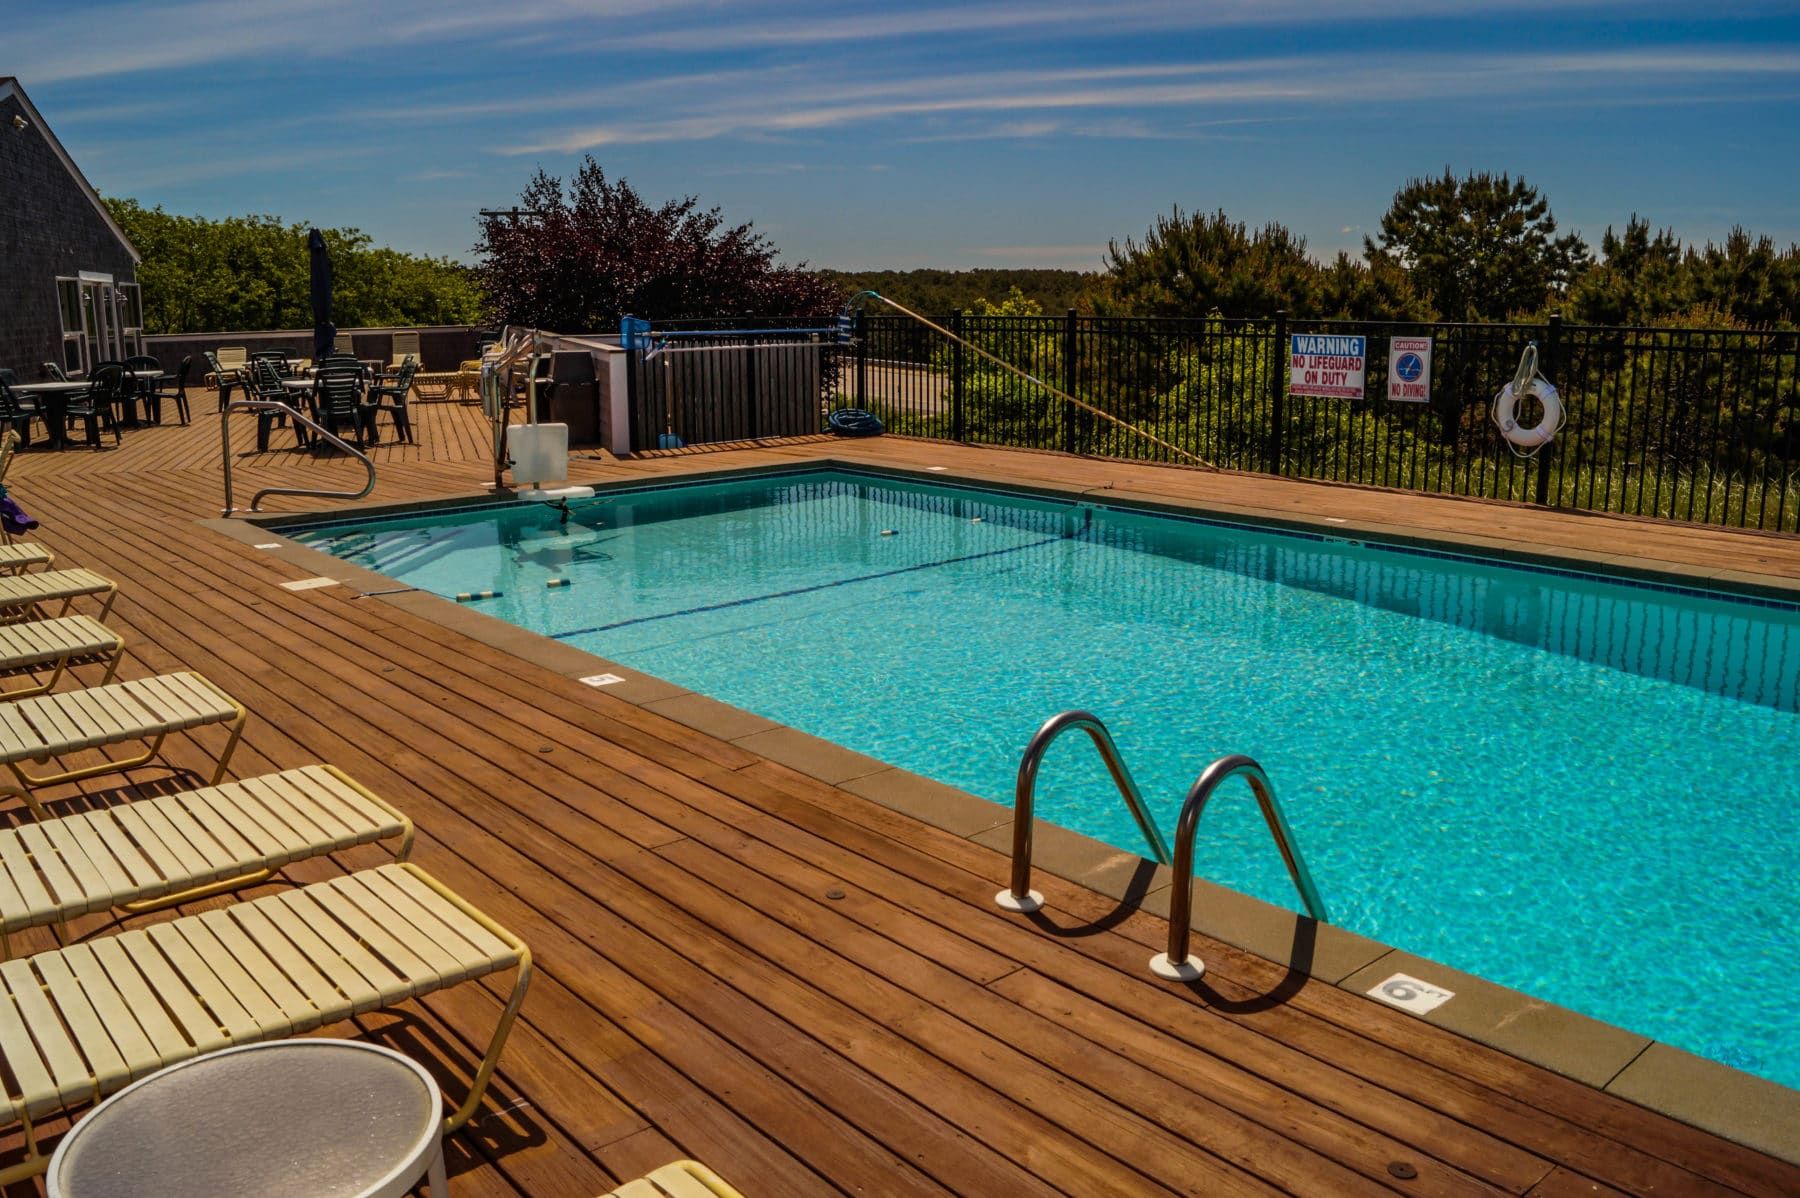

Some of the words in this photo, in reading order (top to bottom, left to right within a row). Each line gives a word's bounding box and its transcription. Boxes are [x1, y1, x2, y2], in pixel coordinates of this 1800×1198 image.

[1297, 336, 1359, 356] WARNING
[1292, 355, 1305, 369] NO
[1309, 356, 1362, 371] LIFEGUARD
[1304, 370, 1318, 384] ON
[1321, 371, 1348, 386] DUTY
[1391, 383, 1400, 397] NO
[1382, 980, 1424, 1001] 6
